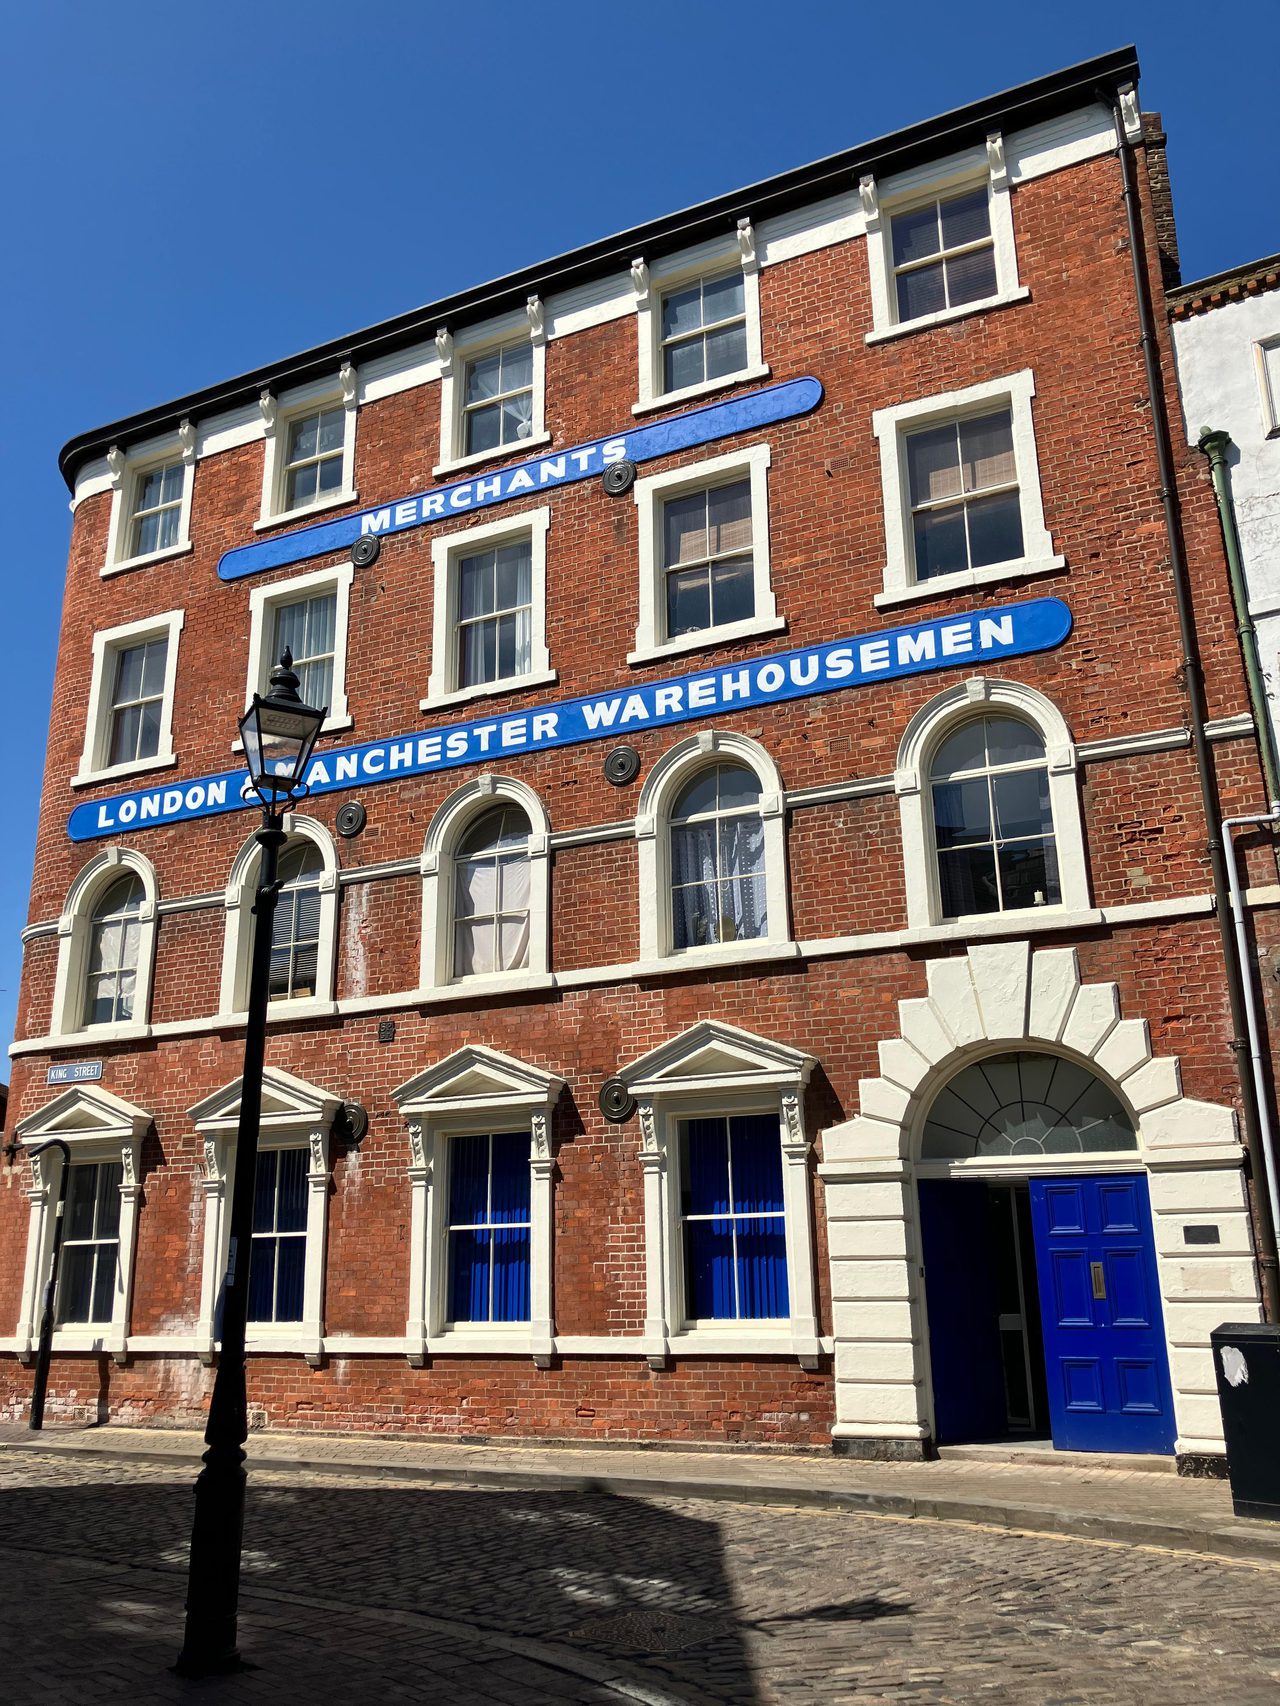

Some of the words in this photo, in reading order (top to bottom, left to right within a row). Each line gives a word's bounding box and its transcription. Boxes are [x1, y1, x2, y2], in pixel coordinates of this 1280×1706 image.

[361, 438, 627, 536] MERCHANTS
[97, 780, 227, 829] LONDON
[581, 615, 1014, 730] WAREHOUSEMEN
[50, 1068, 67, 1080] KING
[74, 1065, 98, 1077] STREET
